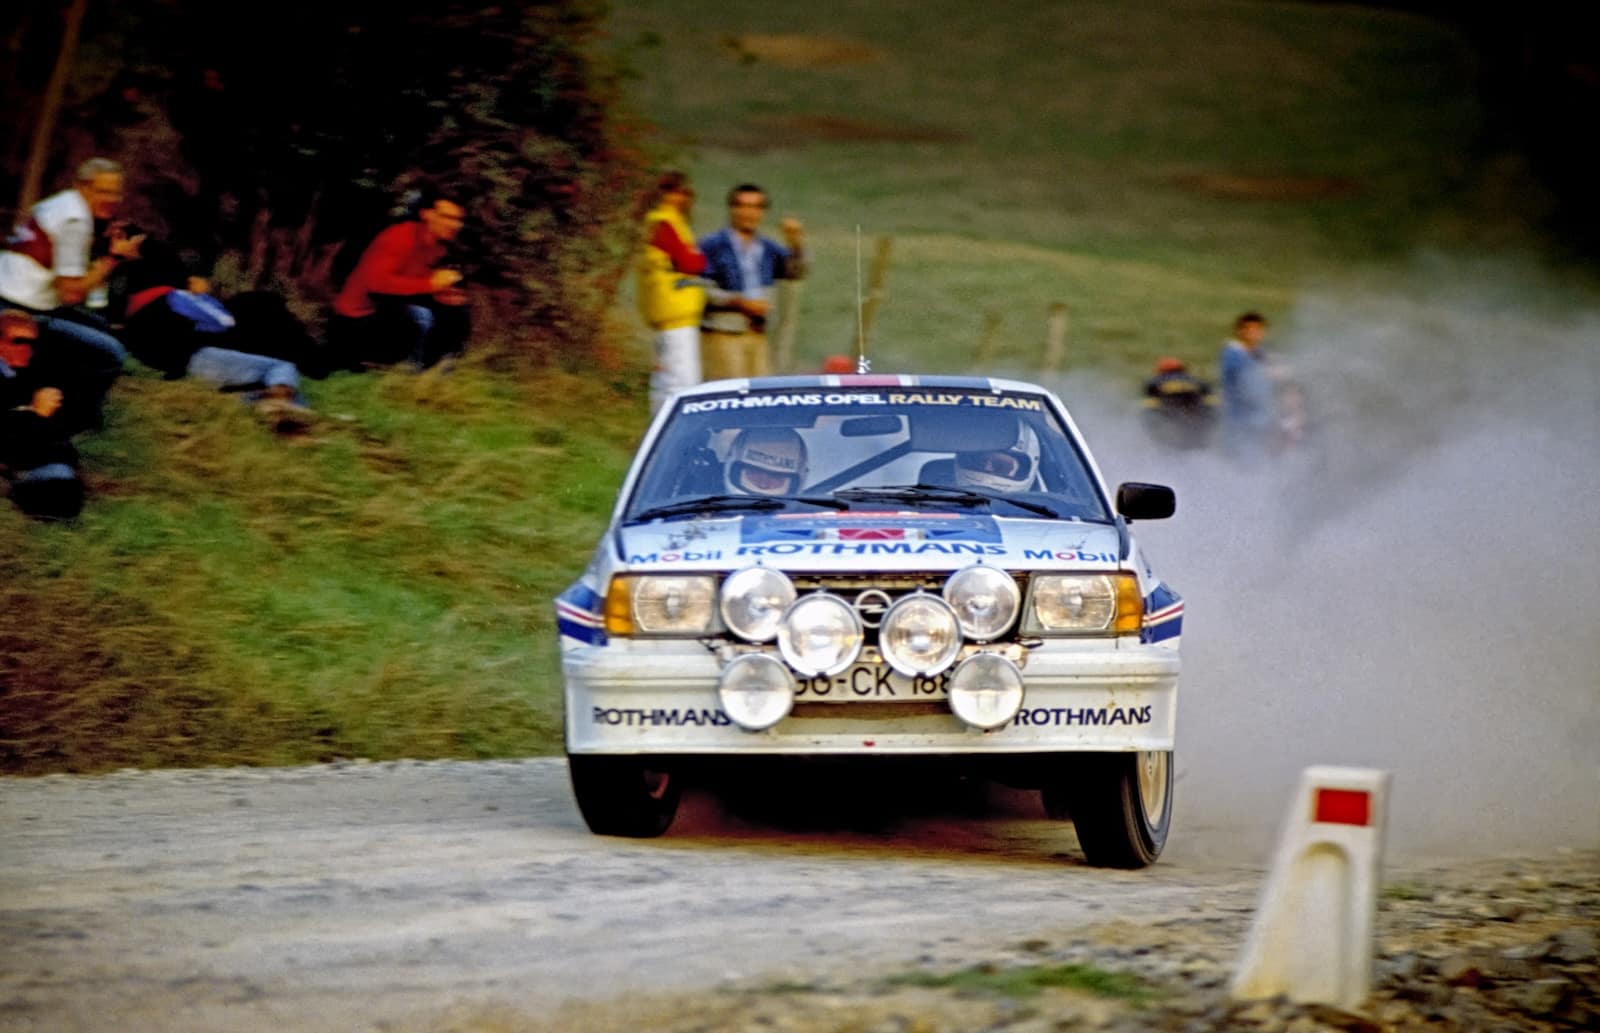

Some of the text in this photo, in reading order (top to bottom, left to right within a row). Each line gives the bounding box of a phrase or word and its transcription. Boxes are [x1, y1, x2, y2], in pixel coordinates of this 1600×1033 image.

[682, 393, 1041, 414] ROTHMANS OPEL RALLY TEAM
[629, 550, 722, 564] Mobil
[736, 542, 1007, 556] ROTHMANS
[1024, 549, 1118, 563] Mobil
[593, 706, 731, 726] ROTHMANS
[1013, 705, 1152, 726] ROTHMANS
